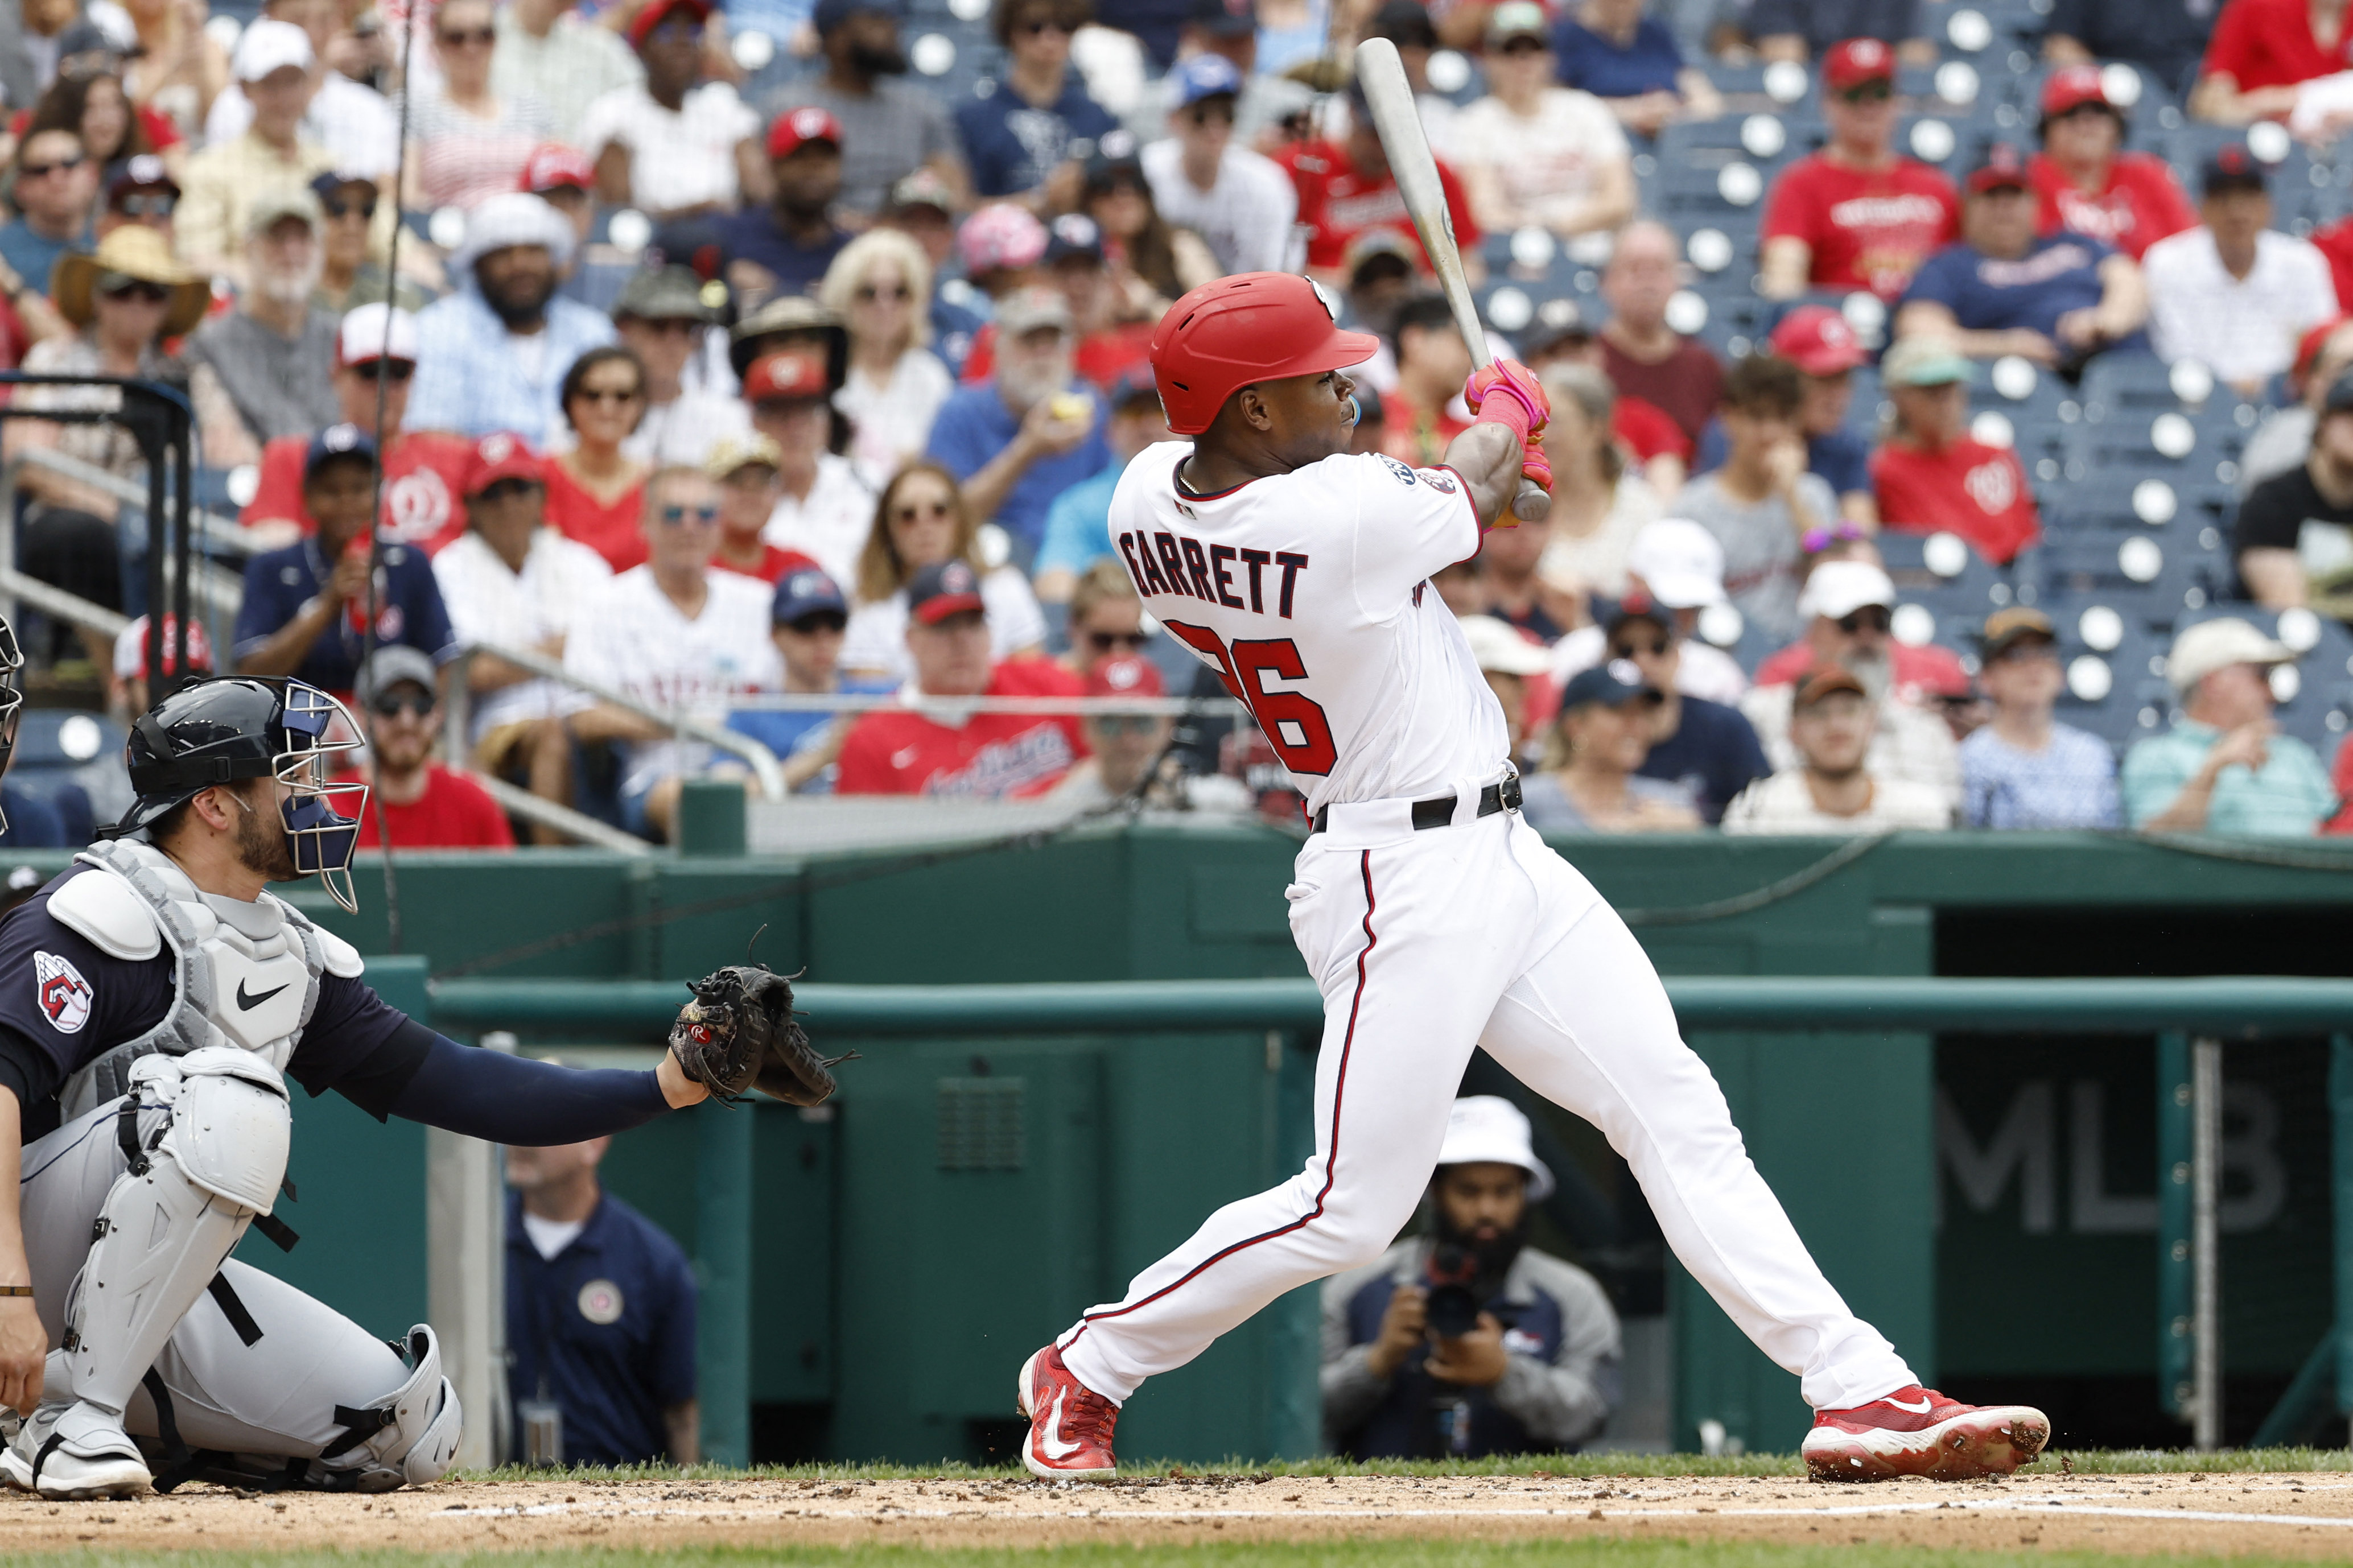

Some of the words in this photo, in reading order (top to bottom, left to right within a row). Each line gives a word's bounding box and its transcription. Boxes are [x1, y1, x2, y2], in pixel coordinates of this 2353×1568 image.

[1119, 530, 1308, 619] GARRETT
[691, 1025, 706, 1040] R
[1933, 1079, 2286, 1233] MLB
